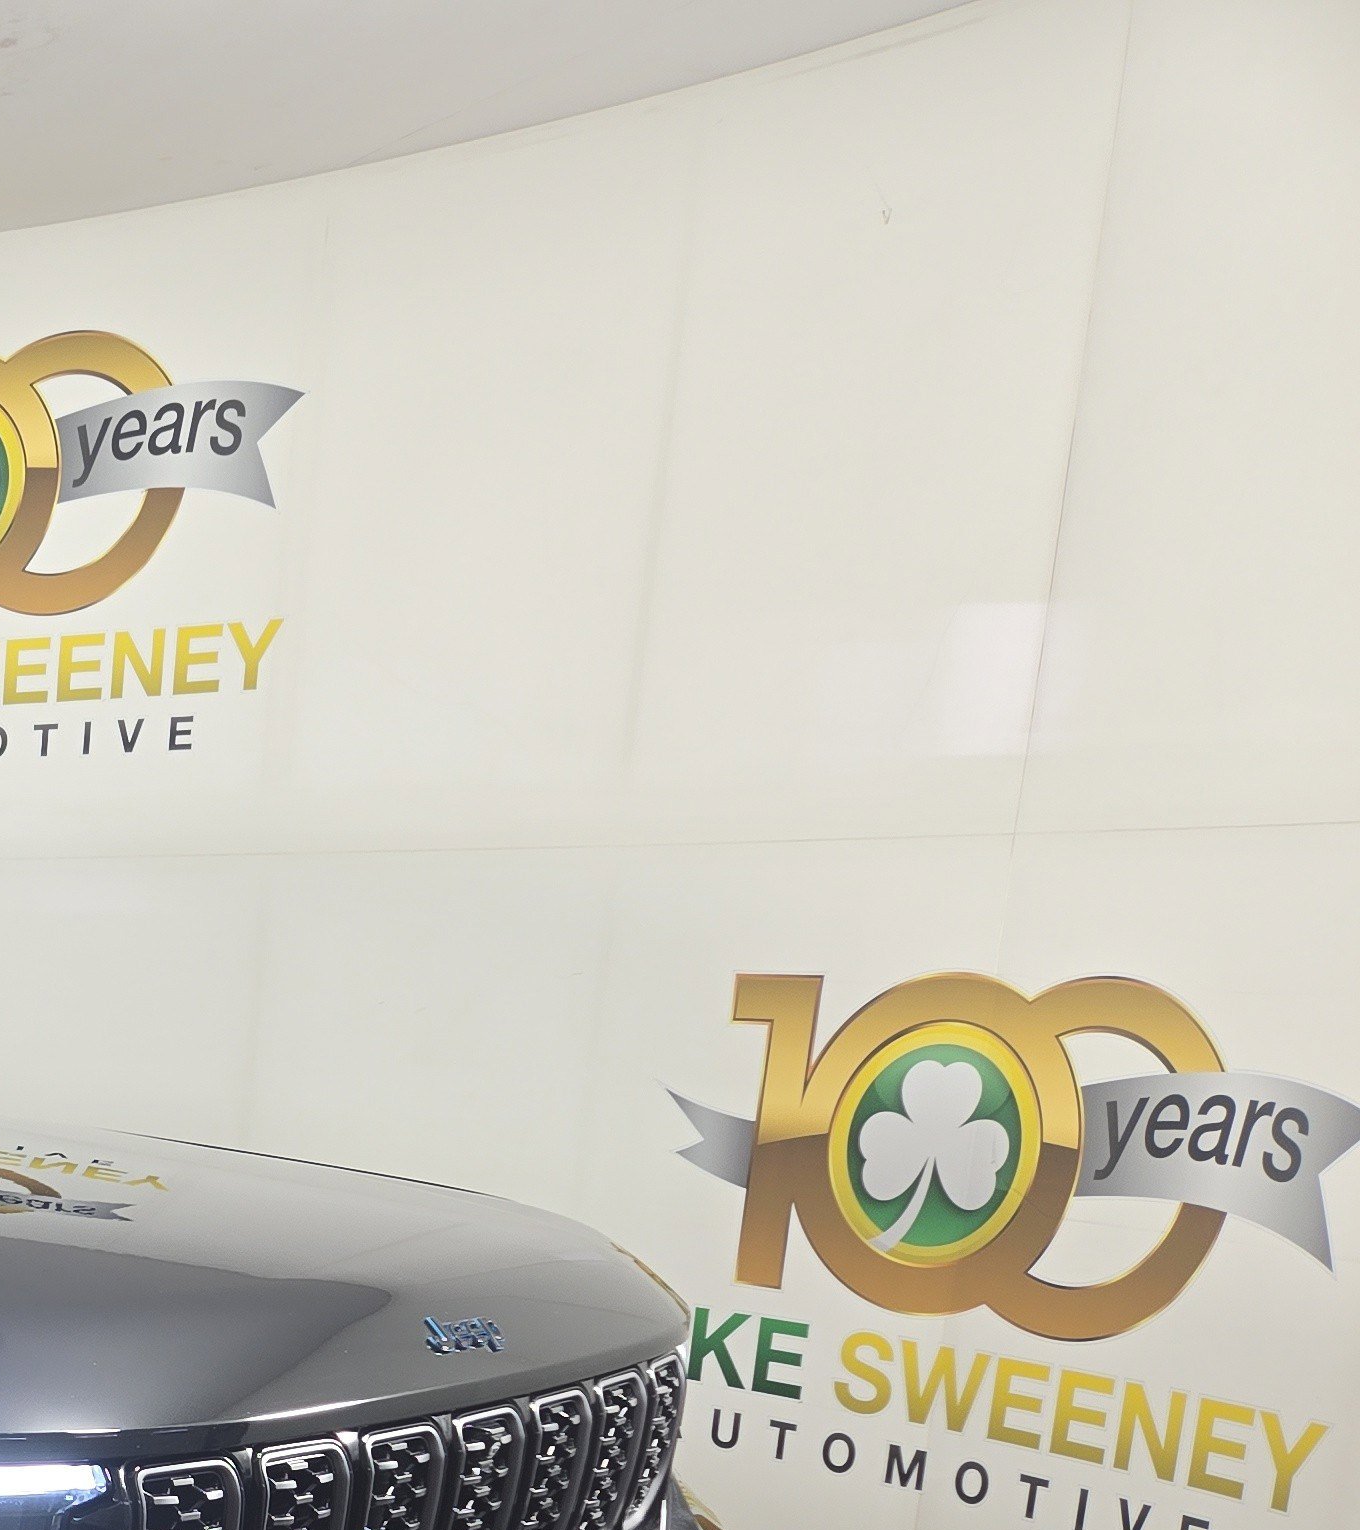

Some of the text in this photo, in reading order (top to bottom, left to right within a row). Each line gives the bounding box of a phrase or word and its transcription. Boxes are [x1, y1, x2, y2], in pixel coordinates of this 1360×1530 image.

[72, 397, 247, 488] years
[1094, 1093, 1310, 1182] years
[423, 1316, 505, 1356] Jeep
[687, 1306, 1328, 1513] KE SWEENEY
